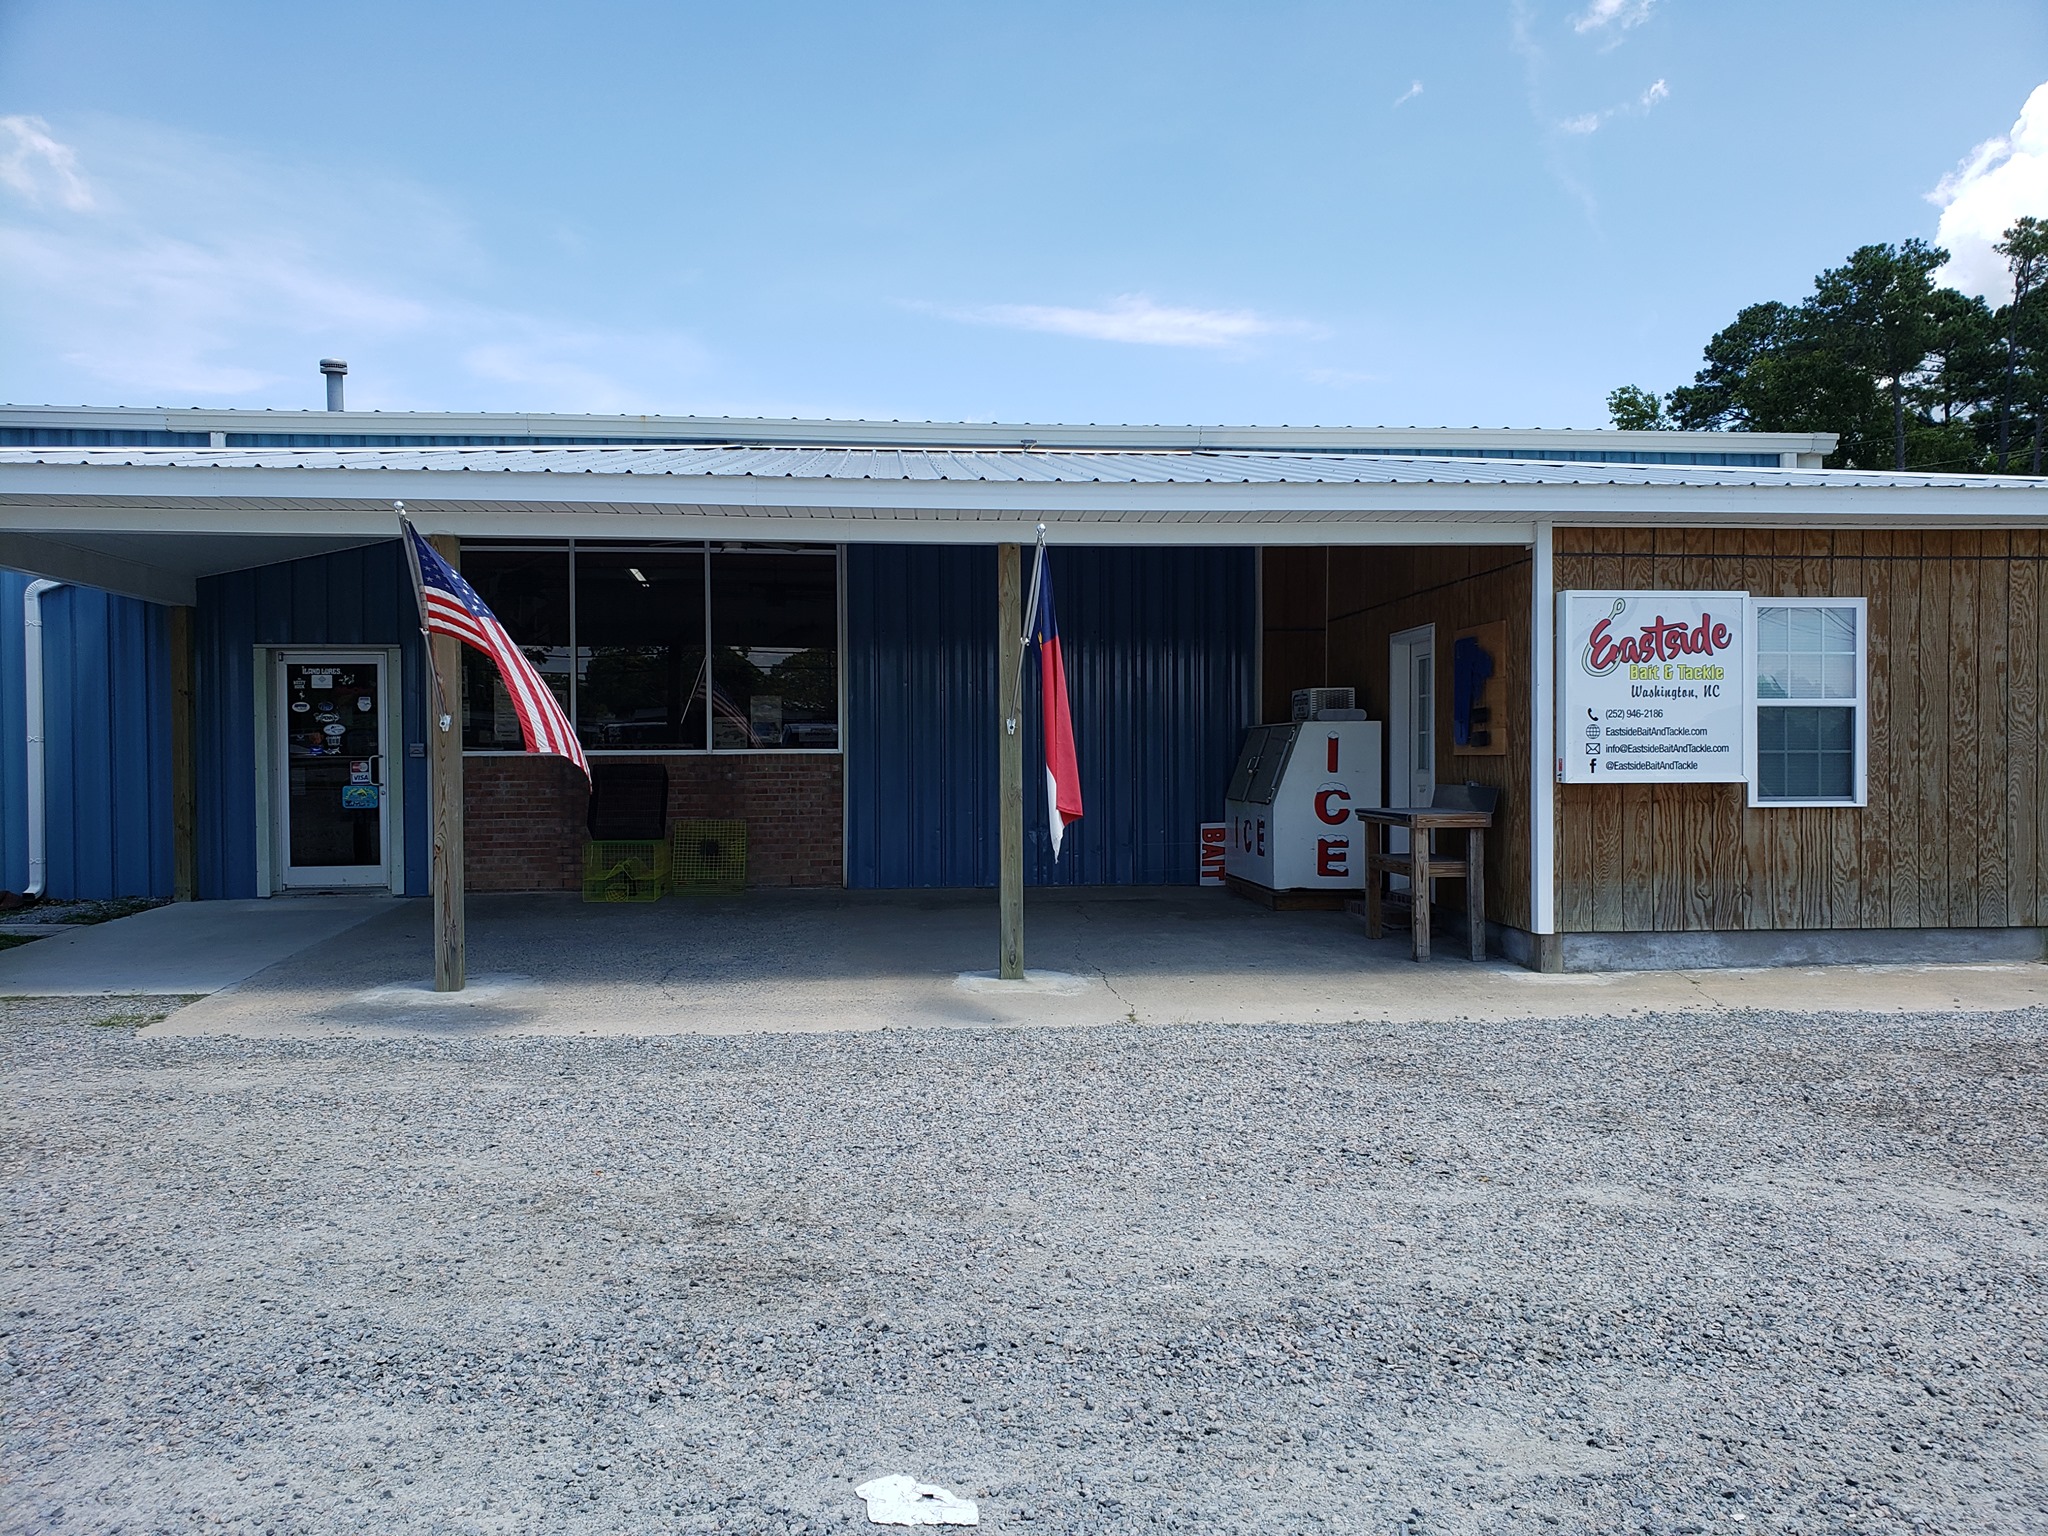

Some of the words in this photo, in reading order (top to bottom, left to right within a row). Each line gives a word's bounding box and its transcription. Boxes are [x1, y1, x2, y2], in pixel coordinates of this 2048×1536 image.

[1589, 612, 1733, 670] Eastside
[1629, 664, 1660, 681] Bait
[1664, 664, 1674, 681] &
[1677, 664, 1724, 681] Tackle
[1631, 684, 1699, 700] Washington,
[1703, 684, 1721, 697] NC
[1605, 709, 1625, 720] (252)
[1626, 709, 1664, 719] 946-2186
[1605, 727, 1708, 737] EastsideBaitAndTackle.com
[1605, 743, 1730, 754] info@EastsideBaitAndTackle.com
[1605, 760, 1698, 771] @EastsideBaitAndTackle
[1314, 730, 1351, 877] ICE
[1235, 815, 1265, 857] ICE
[1202, 828, 1226, 881] BAIT
